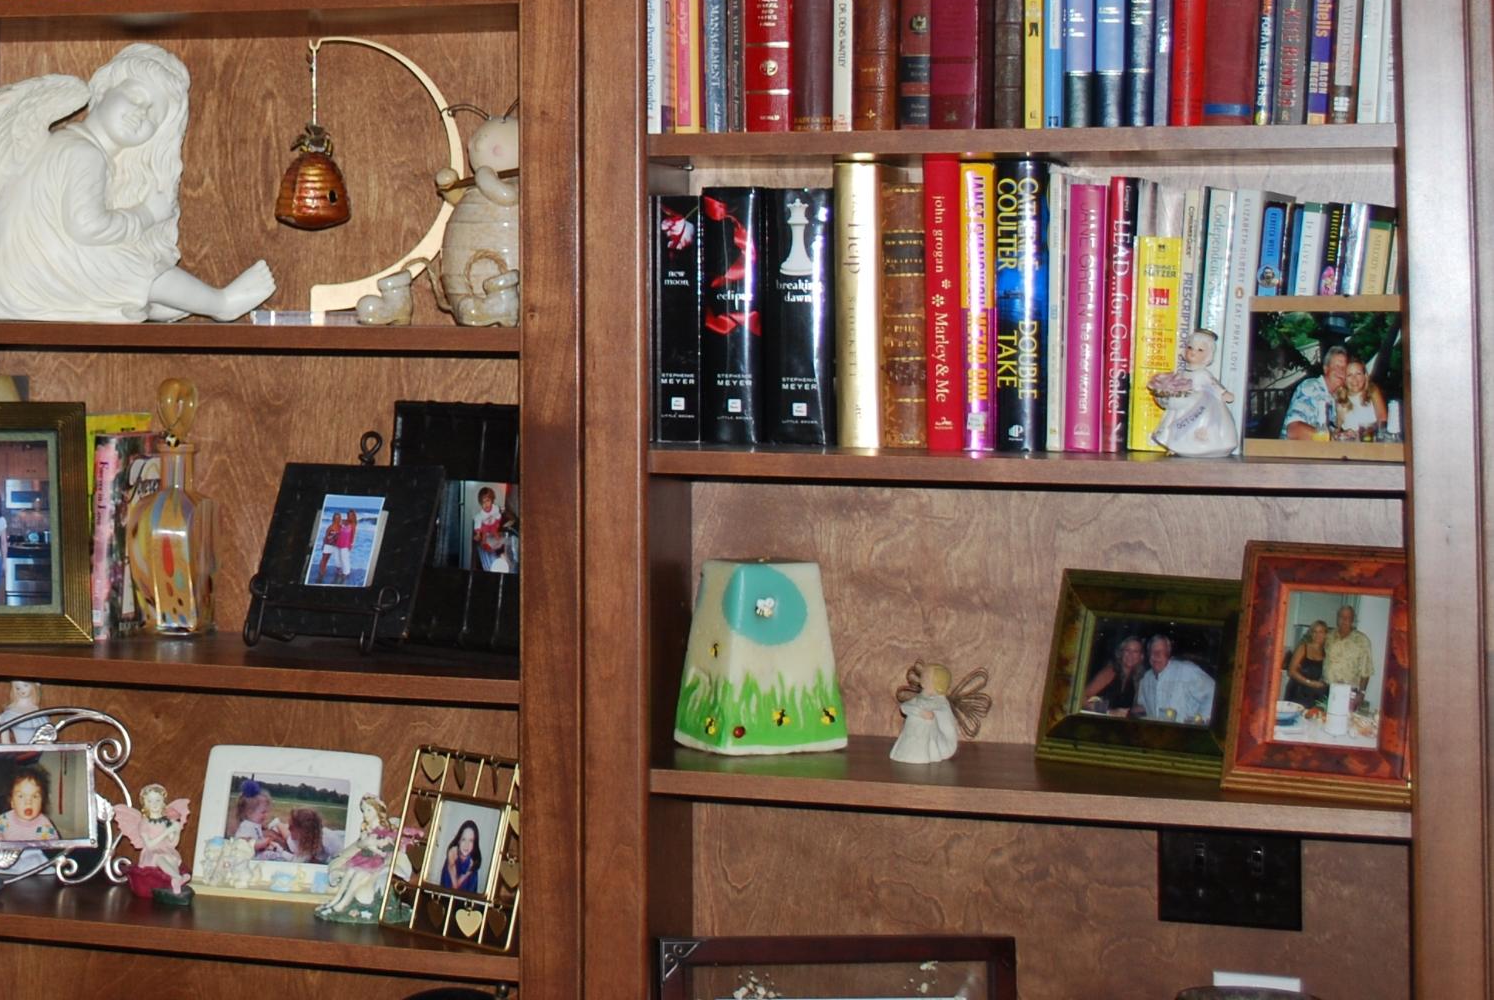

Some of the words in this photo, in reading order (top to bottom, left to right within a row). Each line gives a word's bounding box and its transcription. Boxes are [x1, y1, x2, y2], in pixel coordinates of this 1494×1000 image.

[710, 4, 721, 89] MANAGEMENT
[1261, 17, 1270, 36] FOR
[1318, 62, 1329, 94] MASON
[932, 196, 946, 223] john
[996, 178, 1018, 271] COULTER
[1018, 177, 1039, 271] CATHERINE
[1078, 202, 1096, 248] JANE
[932, 229, 945, 273] grogan
[1077, 254, 1096, 317] GREEN
[932, 312, 949, 361] Marley
[996, 330, 1018, 388] TAKE
[717, 379, 752, 387] MEYER
[935, 364, 949, 376] &
[1017, 320, 1038, 400] DOUBLE
[935, 379, 950, 403] Me
